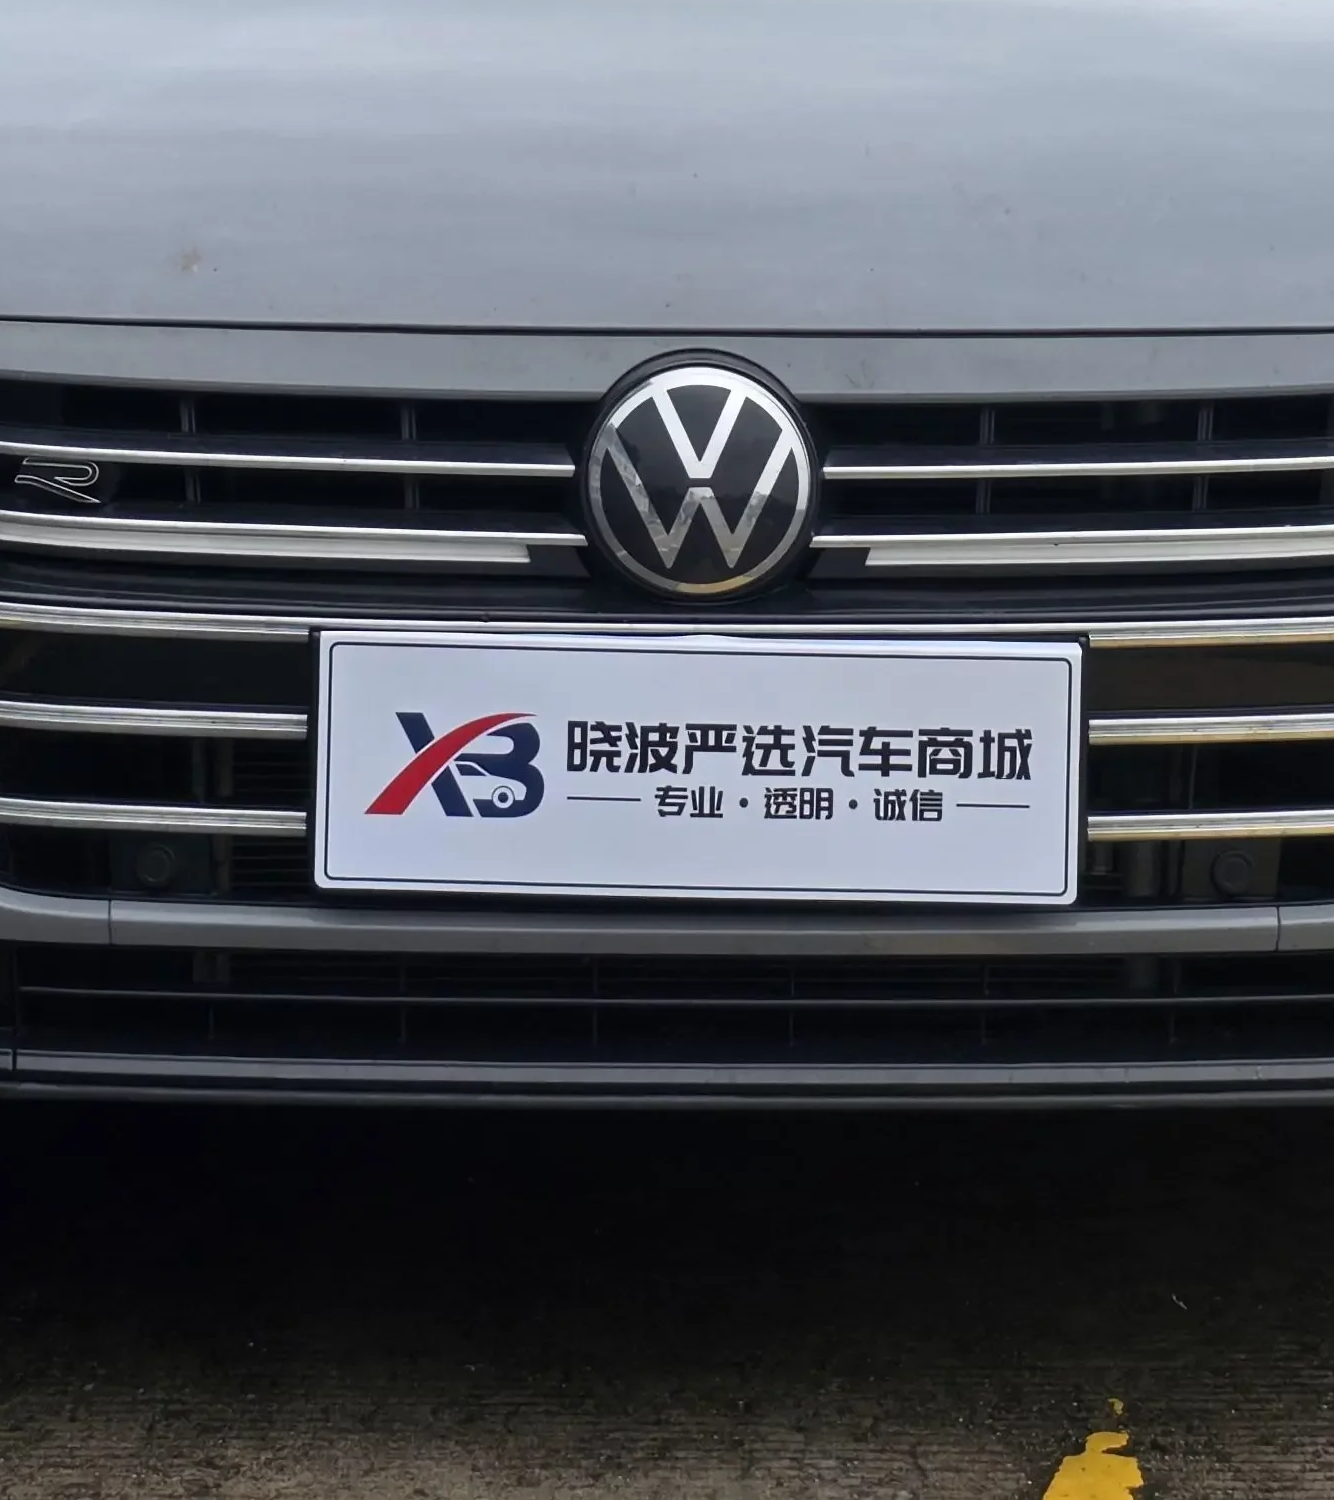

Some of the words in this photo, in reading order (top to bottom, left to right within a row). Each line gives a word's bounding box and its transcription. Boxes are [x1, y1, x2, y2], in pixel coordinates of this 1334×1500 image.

[566, 720, 1032, 780] 晓波严选汽车商城
